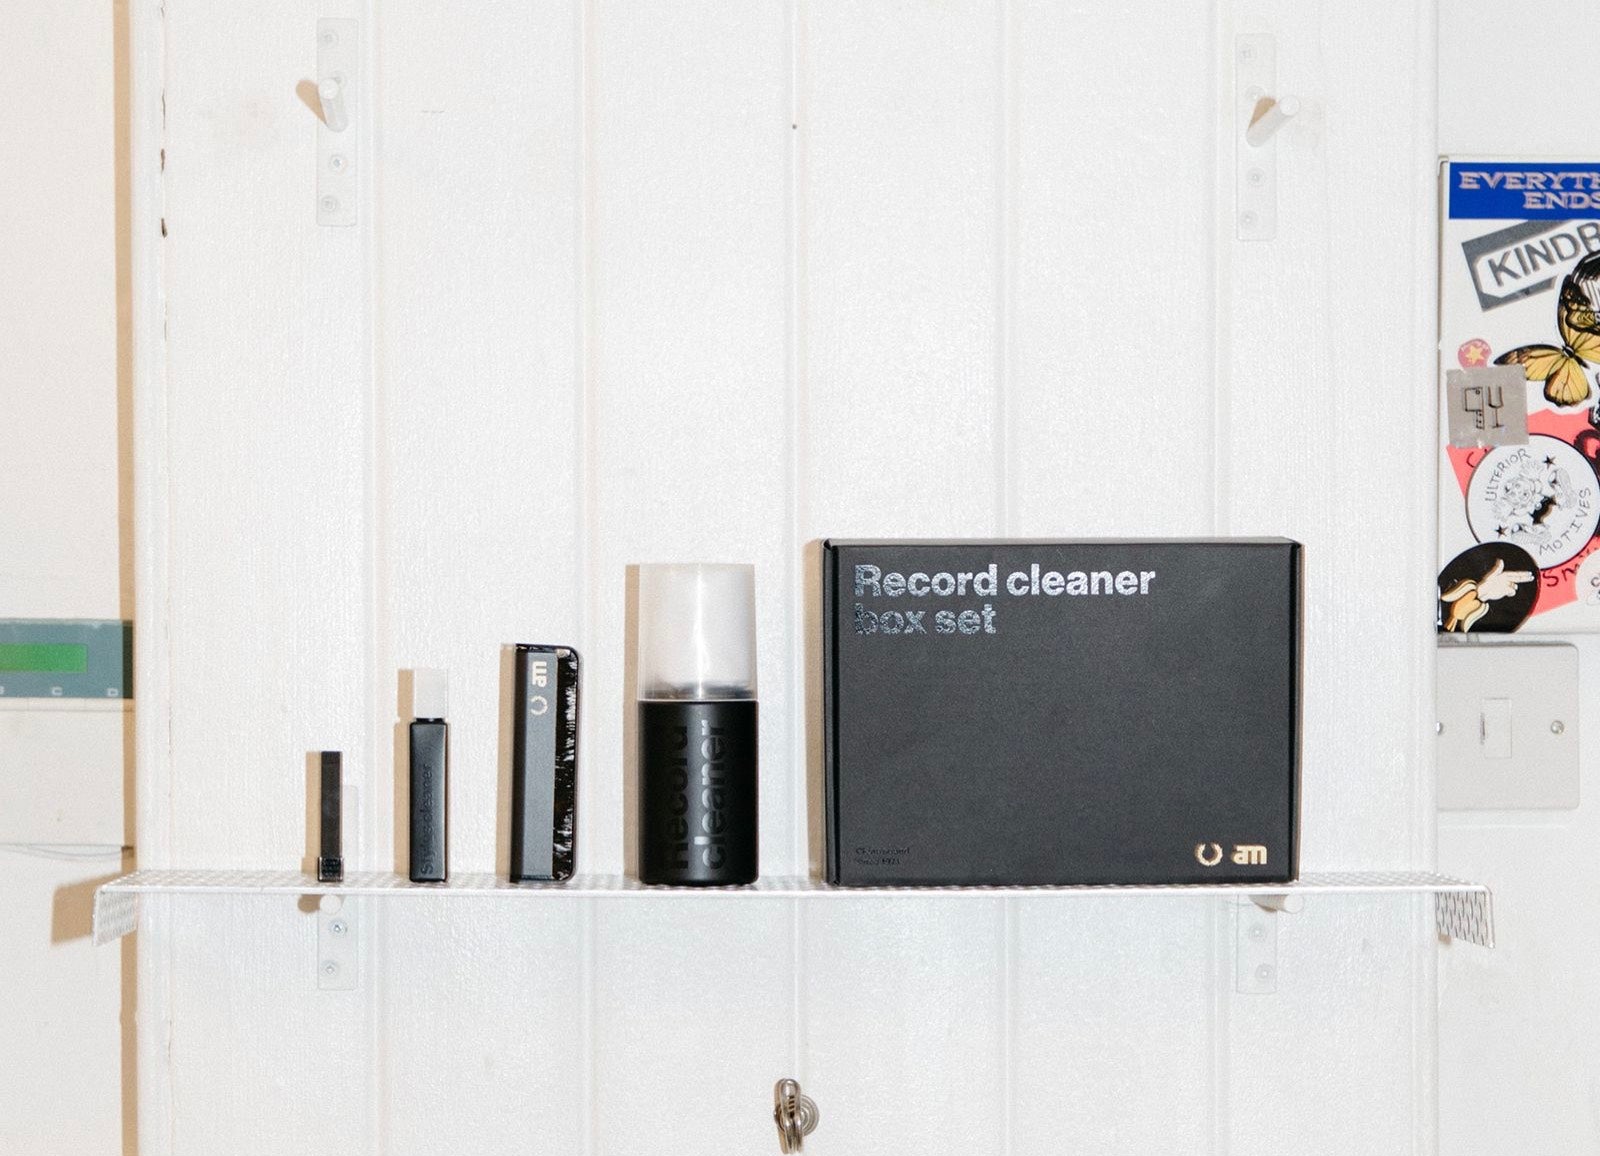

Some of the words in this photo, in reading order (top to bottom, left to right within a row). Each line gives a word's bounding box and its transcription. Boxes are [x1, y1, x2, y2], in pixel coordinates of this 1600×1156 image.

[1484, 447, 1532, 502] ULTERIOR
[1539, 487, 1592, 556] MOTIVES
[855, 564, 998, 597] Record
[1006, 563, 1156, 597] cleaner
[855, 603, 927, 635] box
[935, 603, 997, 635] set
[694, 719, 726, 870] cleaner
[1231, 843, 1268, 865] am
